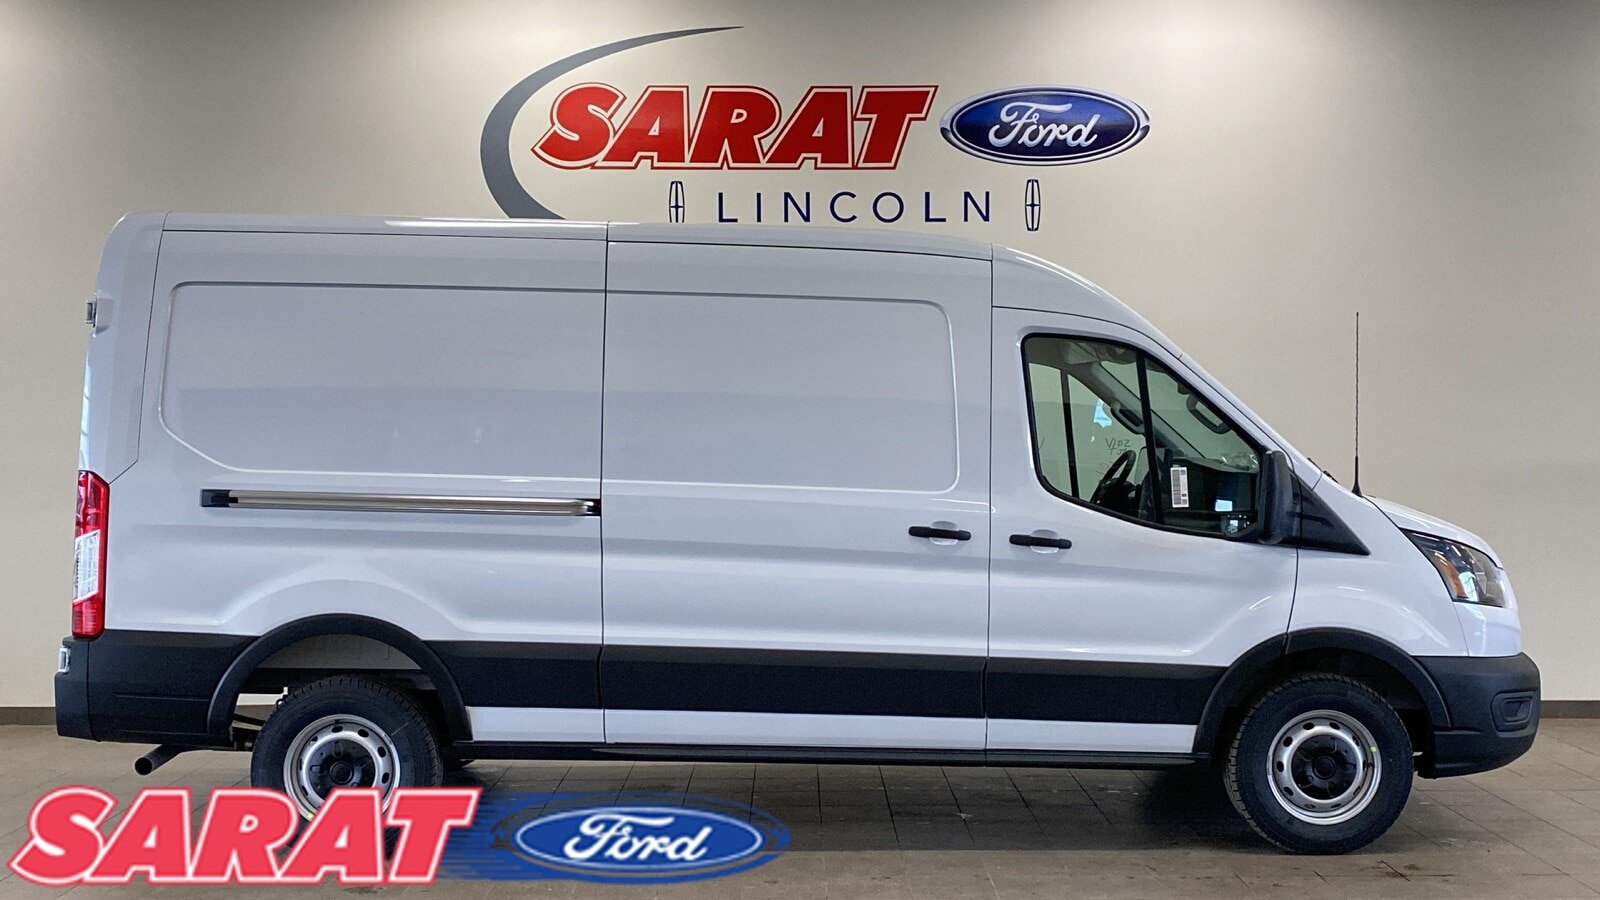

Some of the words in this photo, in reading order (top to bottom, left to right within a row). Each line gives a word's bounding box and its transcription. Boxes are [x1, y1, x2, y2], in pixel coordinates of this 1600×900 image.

[531, 82, 939, 171] SARAT
[988, 101, 1101, 148] Ford
[718, 190, 990, 223] LINCOLN
